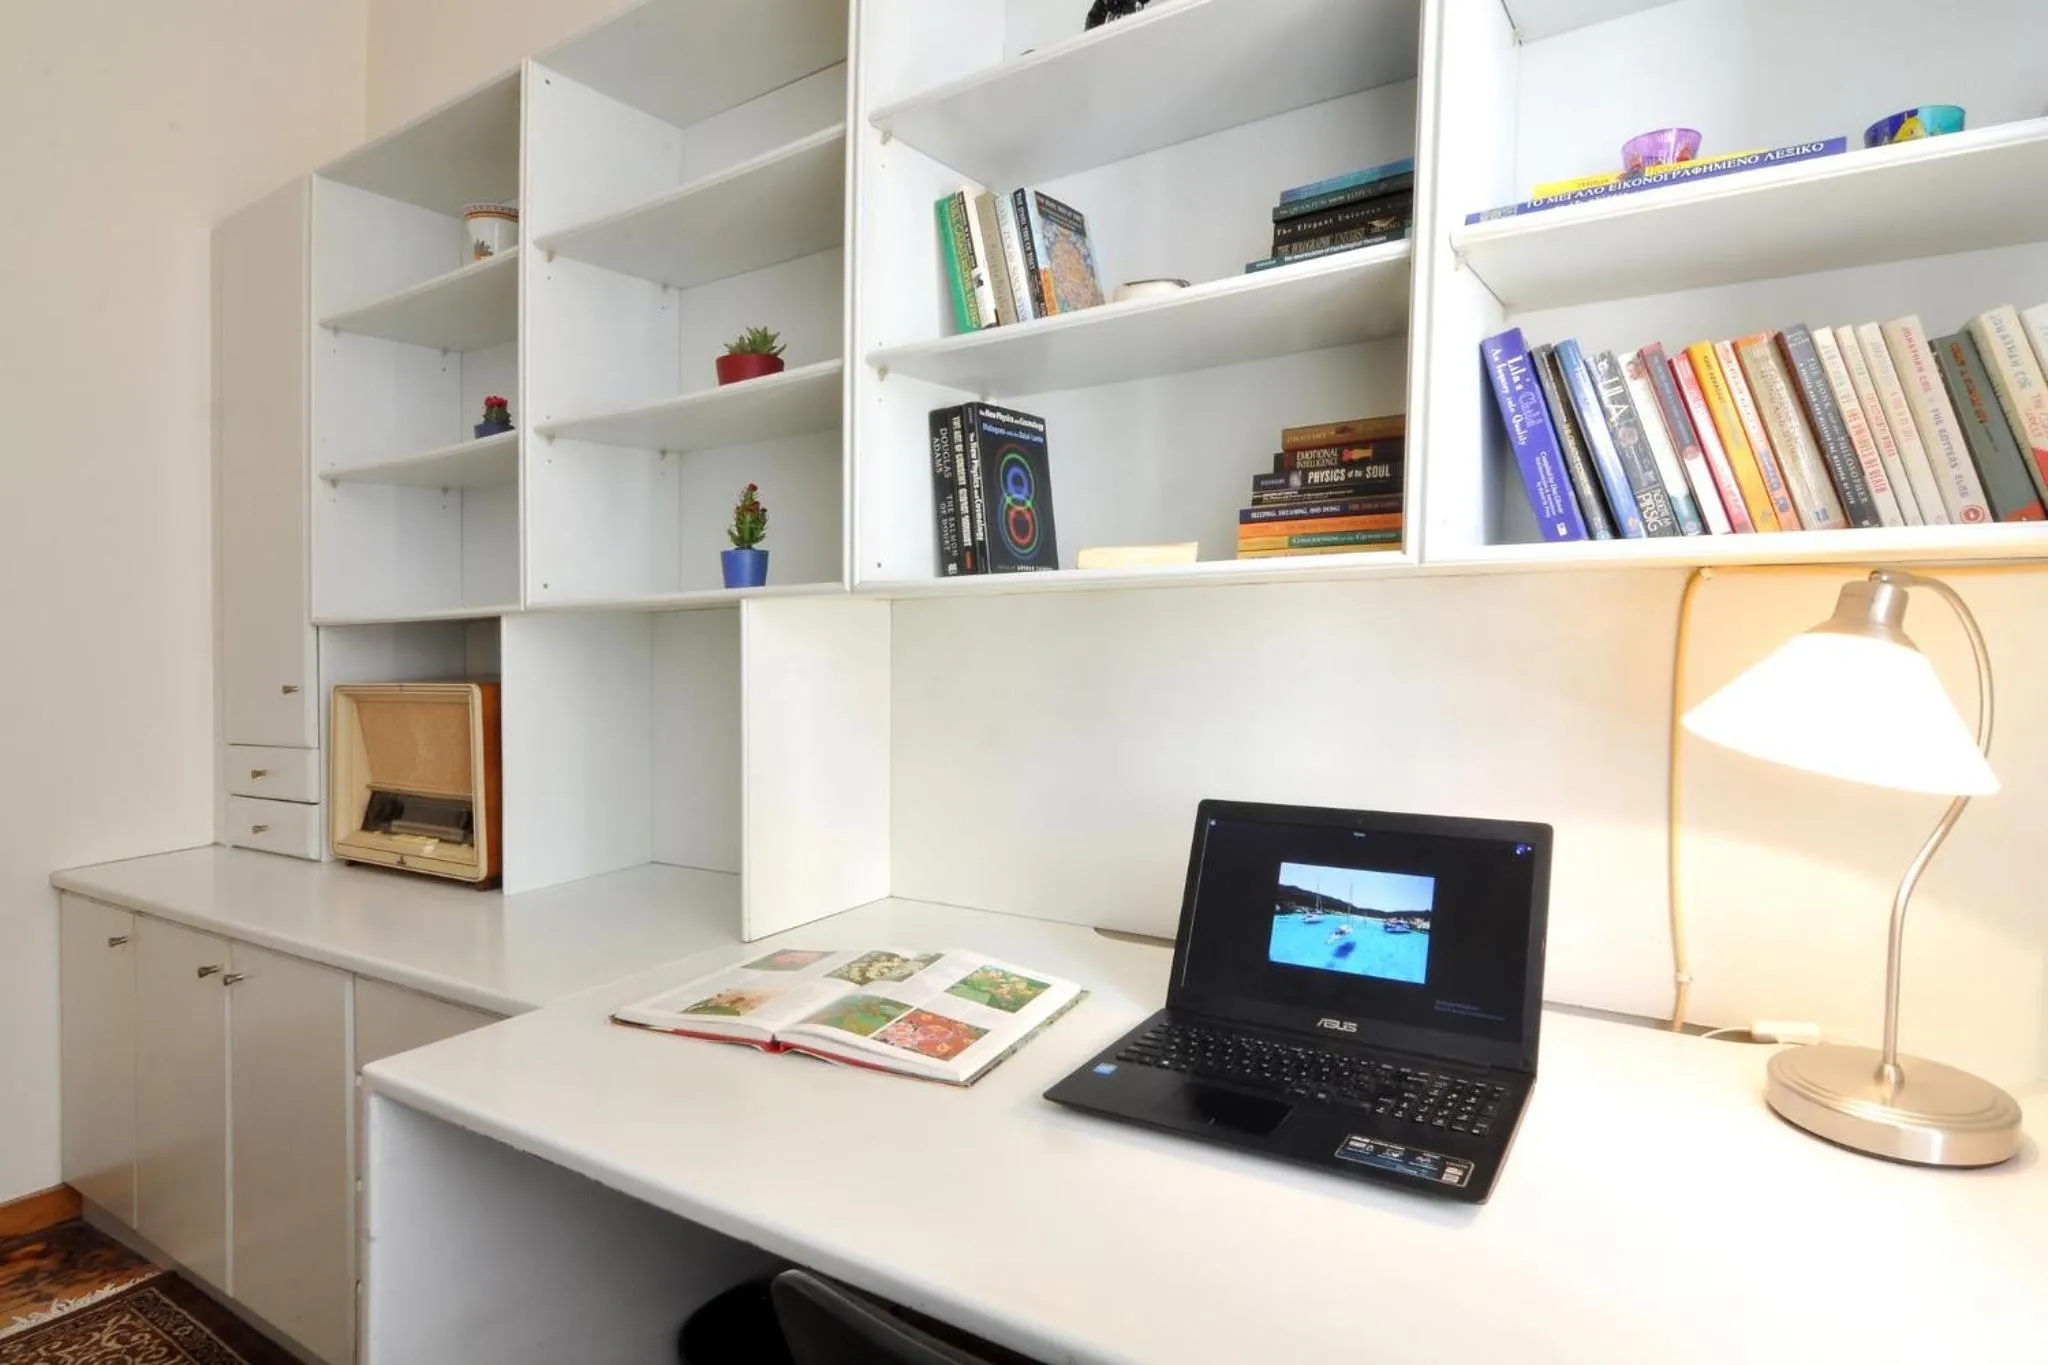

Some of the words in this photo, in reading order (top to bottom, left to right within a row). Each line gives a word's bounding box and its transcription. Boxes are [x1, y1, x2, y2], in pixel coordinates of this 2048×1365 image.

[1763, 142, 1825, 162] ΛΕΞΙΚΟ
[1508, 355, 1530, 391] Lila's
[1601, 376, 1629, 424] LILA
[932, 436, 943, 473] ADAMS
[938, 427, 953, 478] DOUGLAS
[1296, 448, 1340, 461] EMOTIONAL
[969, 458, 981, 488] Physics
[1308, 469, 1346, 484] PHYSICS
[1365, 464, 1391, 479] SOUL
[939, 501, 946, 514] OF
[945, 494, 954, 513] THE
[972, 498, 986, 541] Cosmology
[940, 517, 950, 552] DOUBT
[947, 516, 959, 556] SALMON
[1317, 1017, 1359, 1033] ASUS
